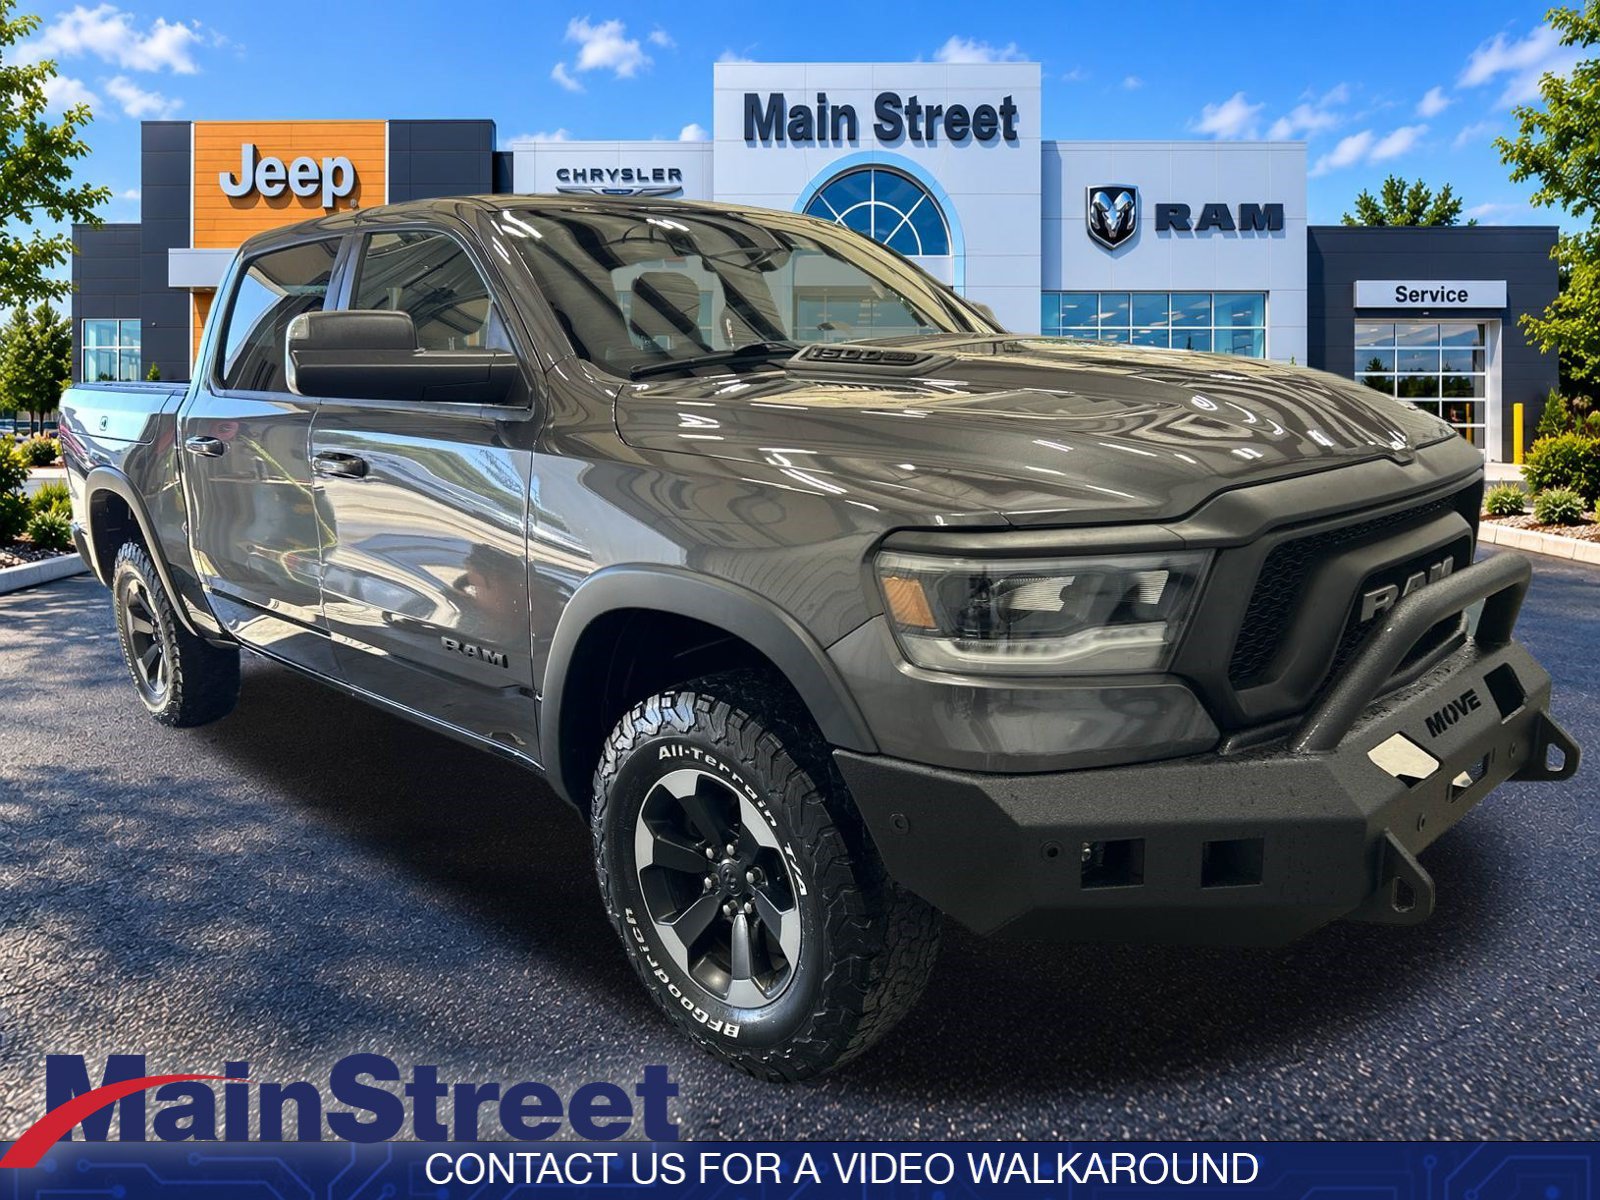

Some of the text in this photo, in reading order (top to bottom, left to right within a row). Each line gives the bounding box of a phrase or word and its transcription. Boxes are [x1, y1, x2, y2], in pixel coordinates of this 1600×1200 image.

[743, 91, 1018, 142] Main Street
[218, 143, 355, 208] Jeep
[556, 167, 683, 182] CHRYSLER
[1155, 203, 1284, 231] RAM
[1395, 285, 1469, 303] Service
[812, 347, 884, 361] 1500
[440, 636, 509, 669] RAM
[1423, 688, 1483, 739] MOVE
[658, 744, 778, 827] All-Terrain
[624, 907, 741, 1039] BFGoodrich
